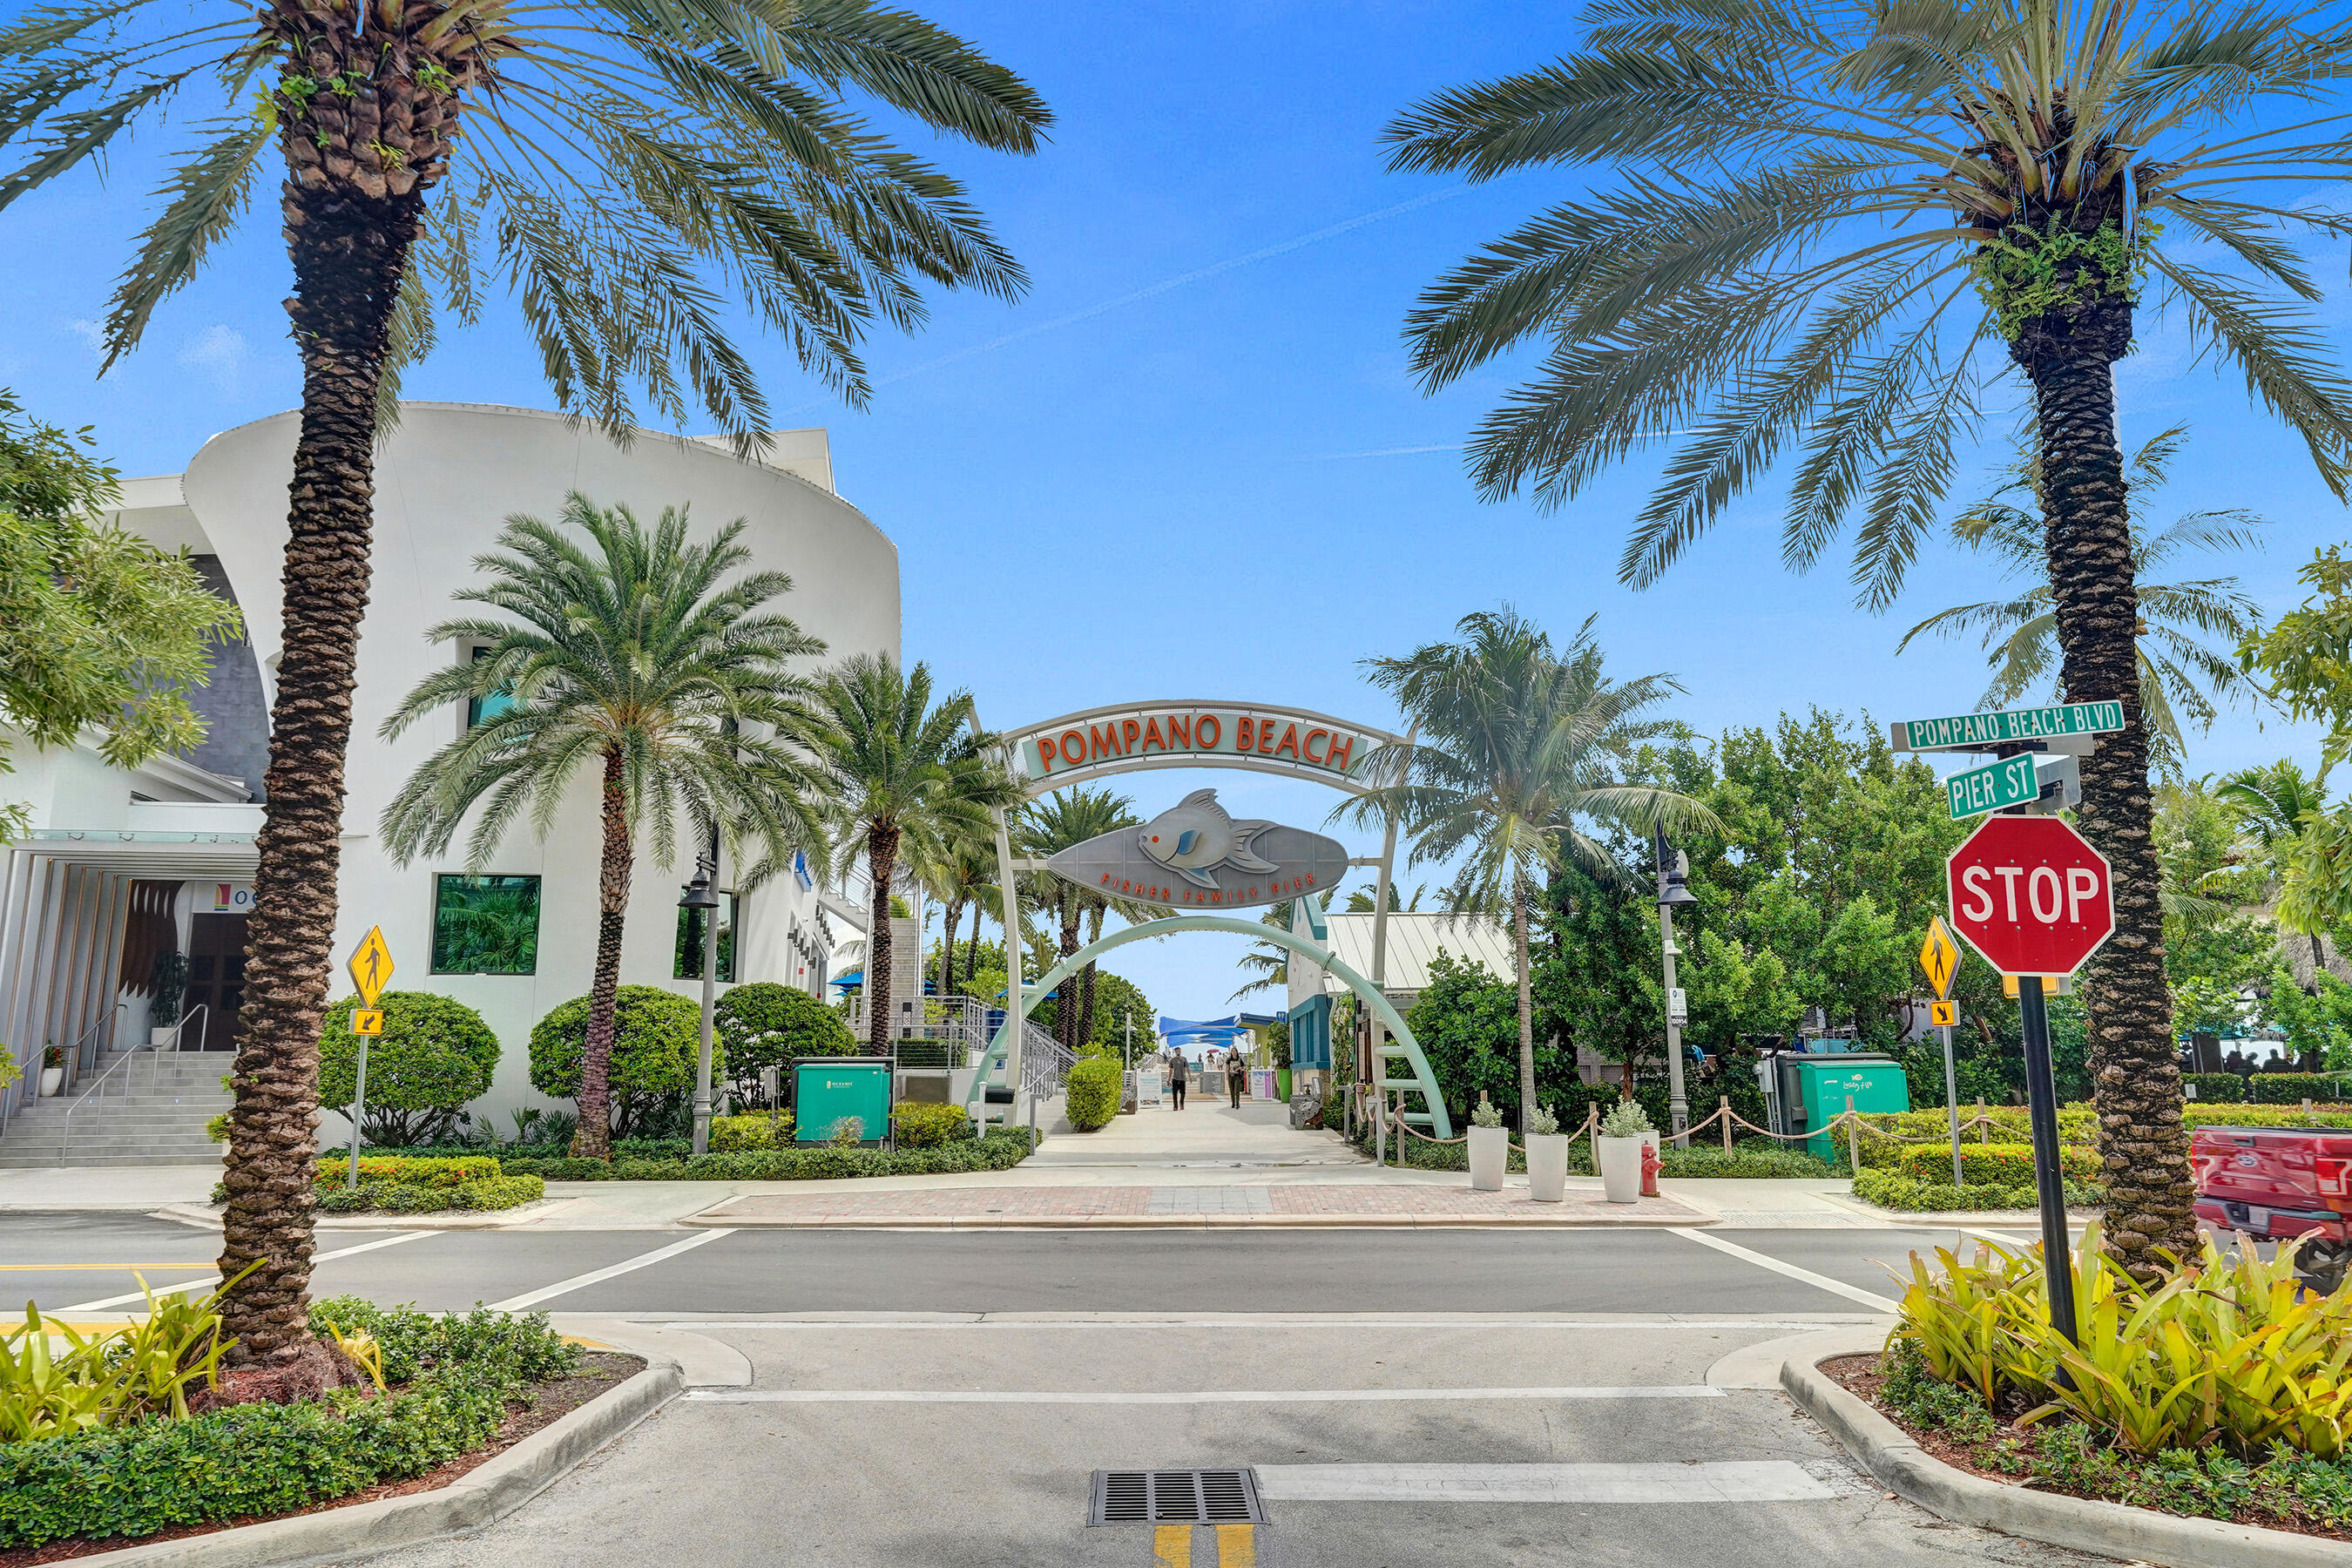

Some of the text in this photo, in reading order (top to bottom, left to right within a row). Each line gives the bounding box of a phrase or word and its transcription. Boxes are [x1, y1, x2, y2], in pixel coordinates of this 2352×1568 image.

[1037, 714, 1354, 773] POMPANO BEACH
[1915, 703, 2118, 747] POMPANO BEACH BLVD
[1951, 760, 2028, 814] PIER ST
[1100, 873, 1315, 903] FISHER FAMILY PIER
[1961, 866, 2099, 924] STOP
